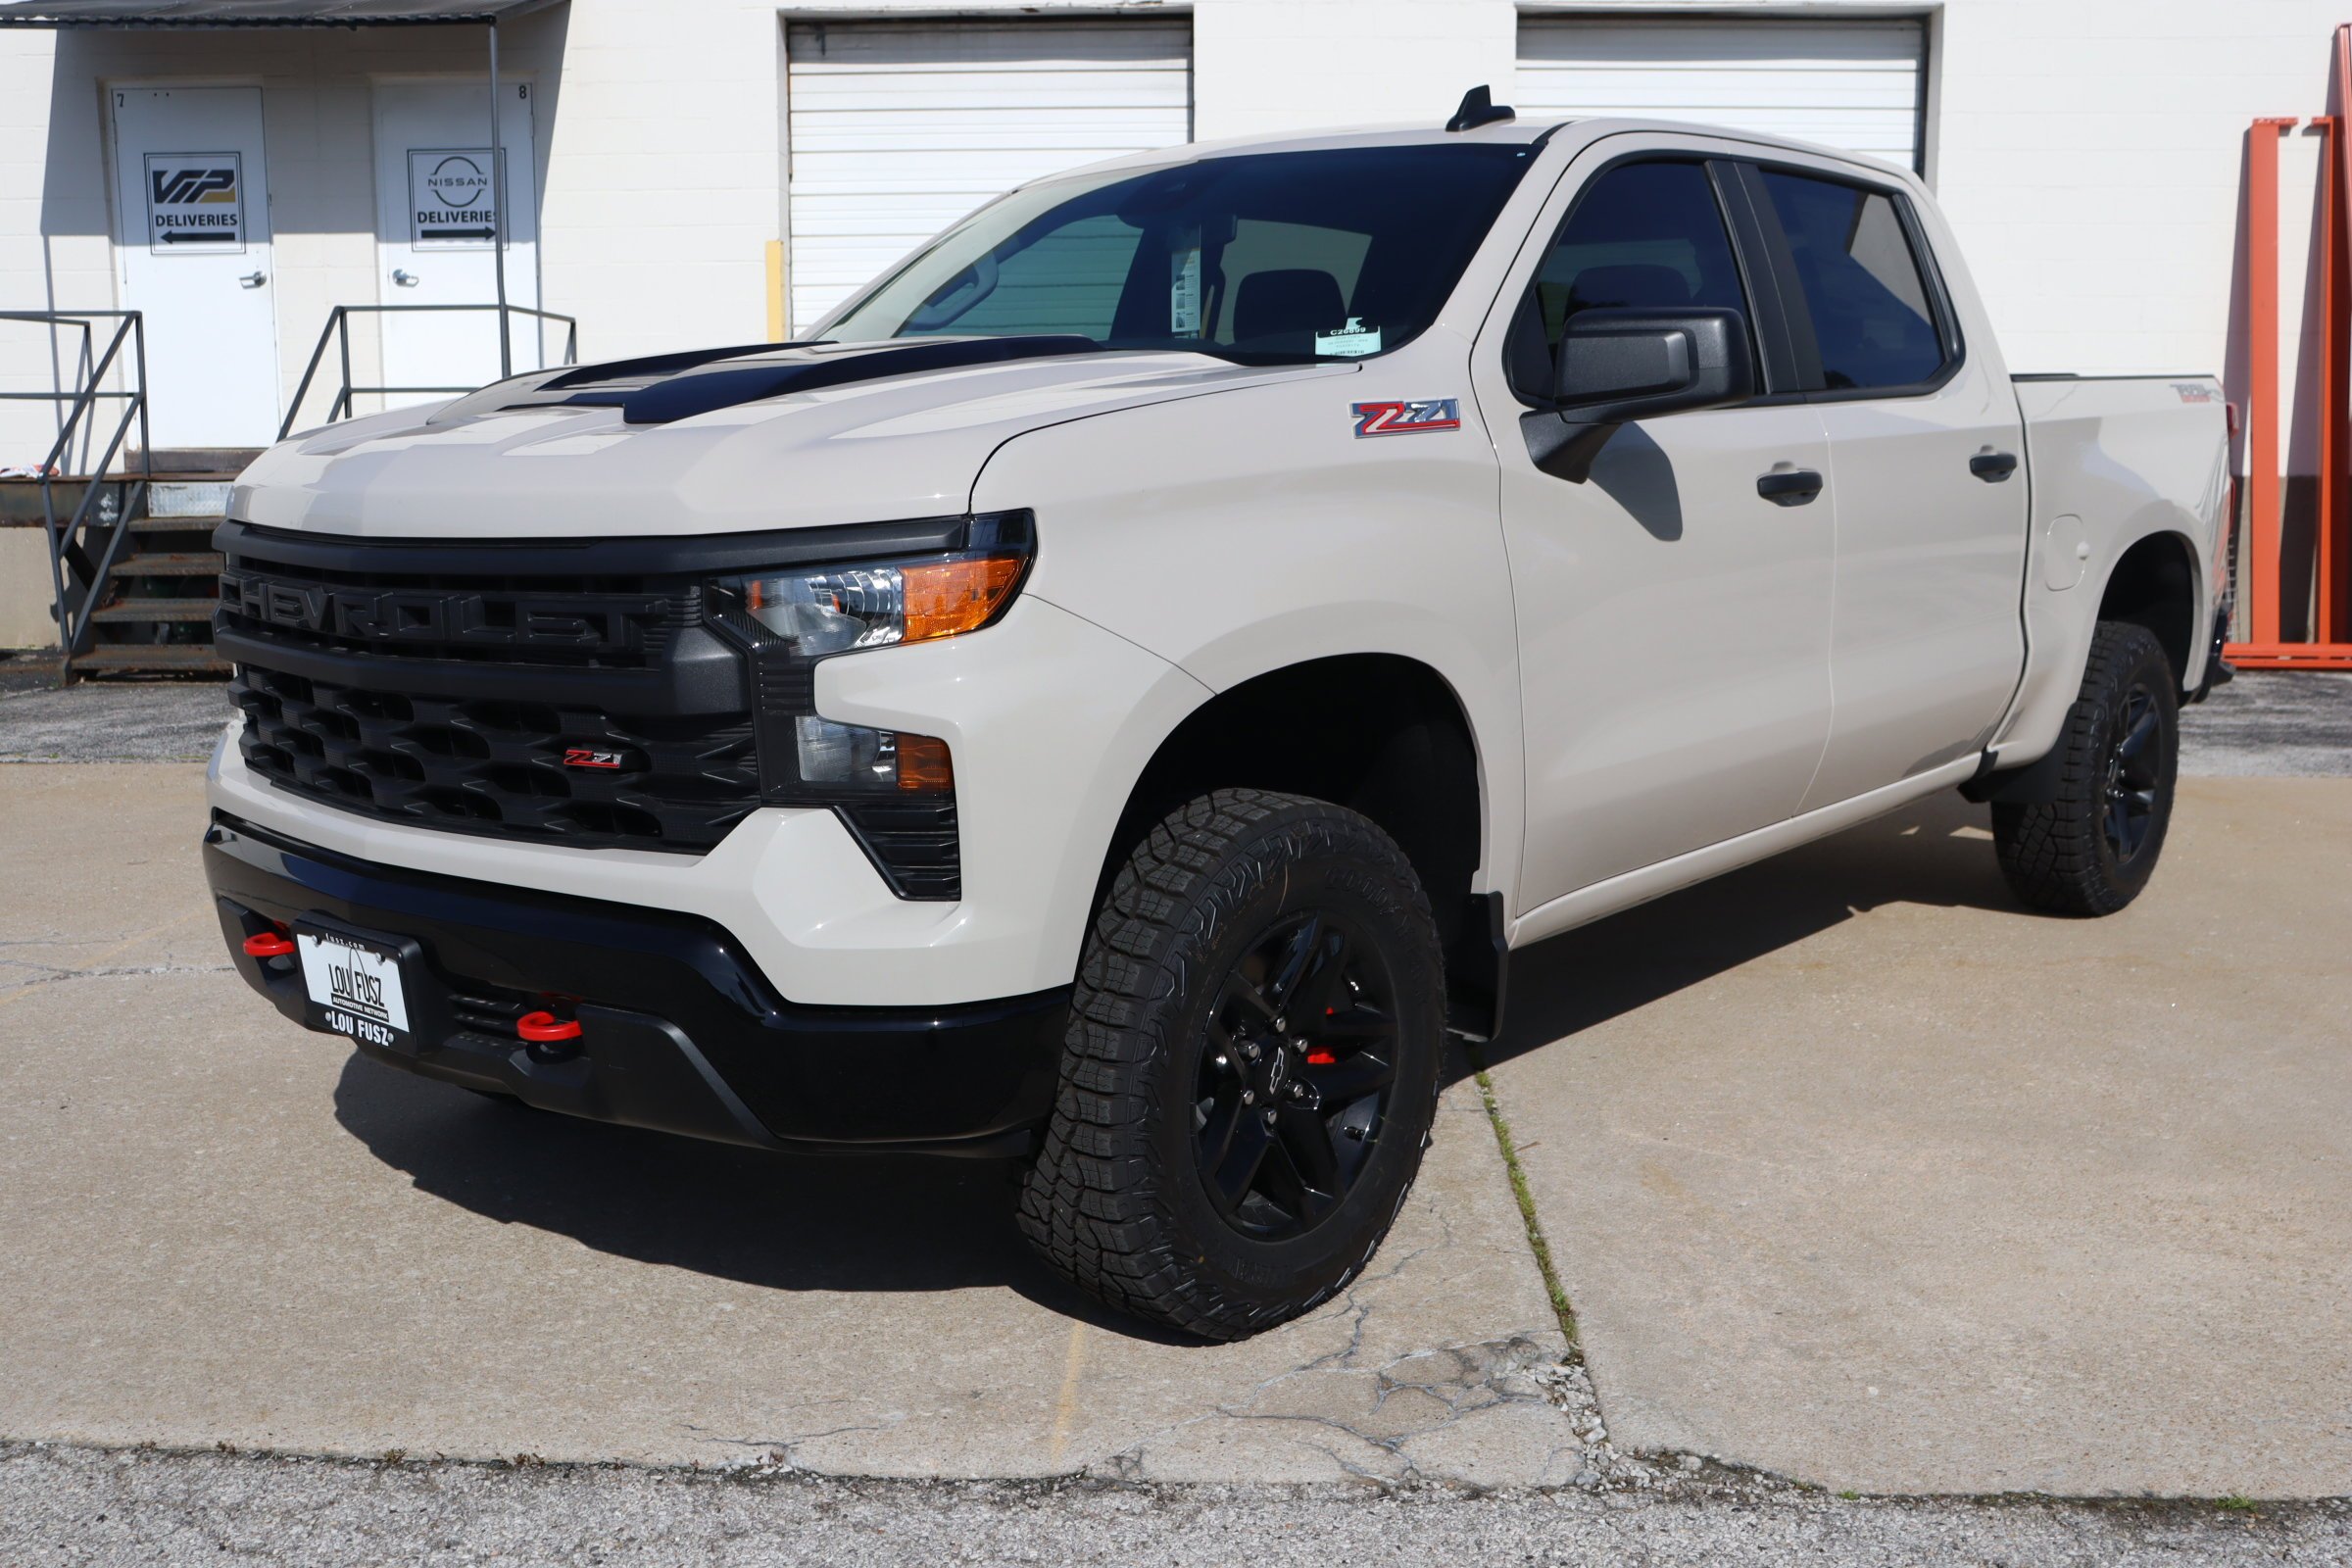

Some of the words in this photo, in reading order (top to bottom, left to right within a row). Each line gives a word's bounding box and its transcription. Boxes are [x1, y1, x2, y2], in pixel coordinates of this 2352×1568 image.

[117, 93, 125, 108] 7
[517, 84, 527, 100] 8
[152, 169, 236, 204] VIP
[427, 177, 487, 186] NISSAN
[155, 214, 238, 227] DELIVERIES
[1349, 397, 1461, 439] Z71
[219, 572, 669, 653] CHEVROLET
[564, 749, 623, 768] Z71
[328, 963, 352, 998] LOU
[354, 971, 385, 1007] FUSZ
[331, 1010, 354, 1035] LOU
[358, 1019, 389, 1047] FUSZ
